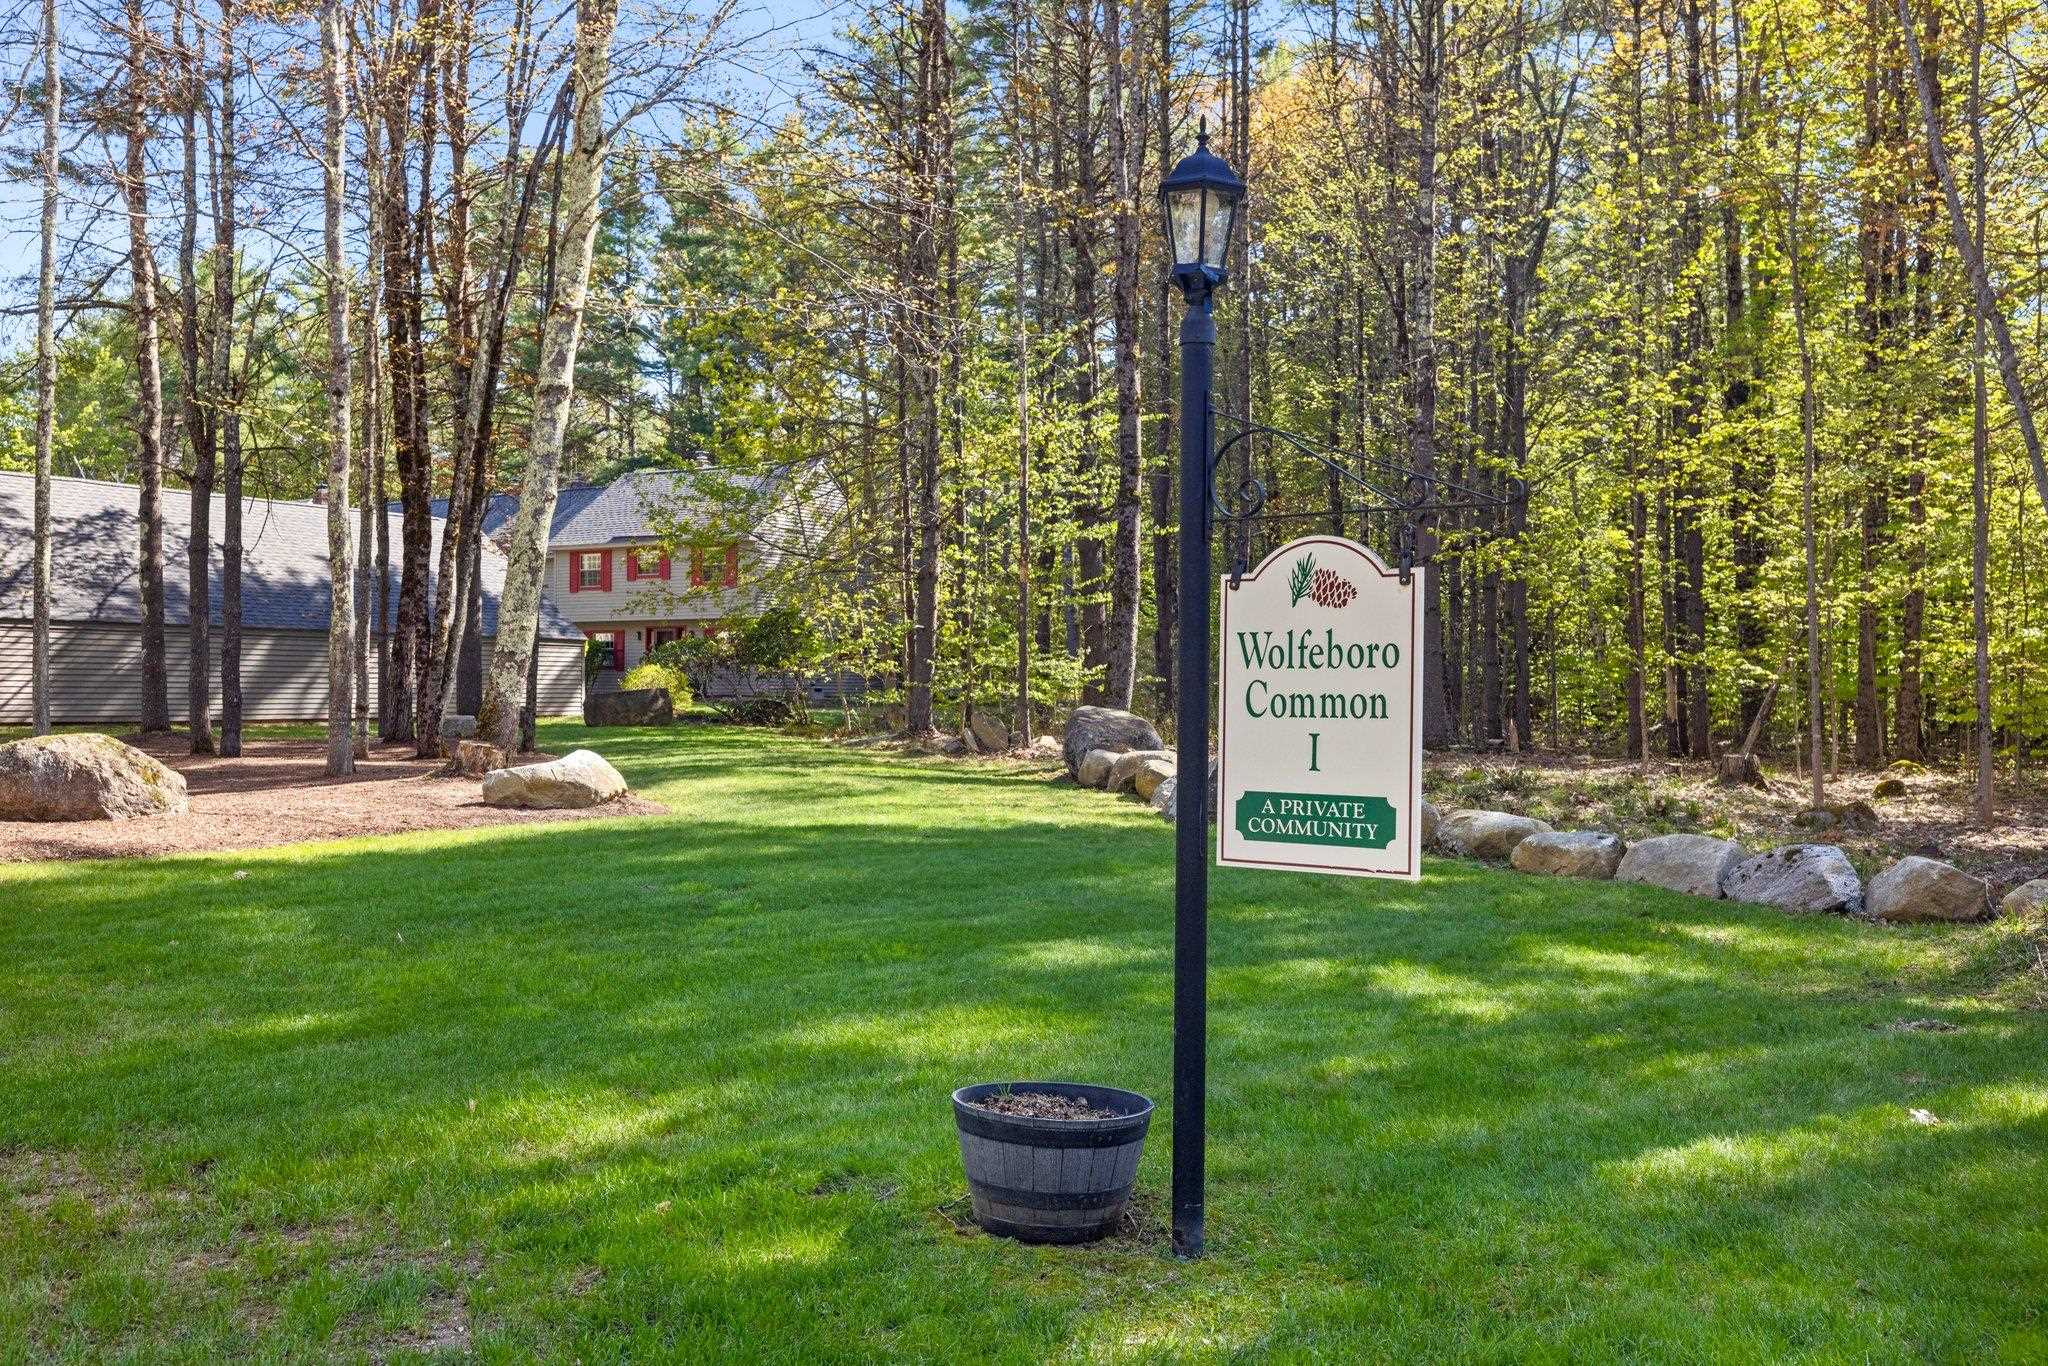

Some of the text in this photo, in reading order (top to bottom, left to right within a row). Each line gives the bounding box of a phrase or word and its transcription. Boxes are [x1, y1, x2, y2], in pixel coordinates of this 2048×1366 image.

[1237, 628, 1400, 670] Wolfeboro
[1245, 679, 1389, 719] Common
[1308, 733, 1320, 772] I
[1248, 817, 1378, 840] COMMUNITY
[1262, 799, 1365, 819] A PRIVATE
